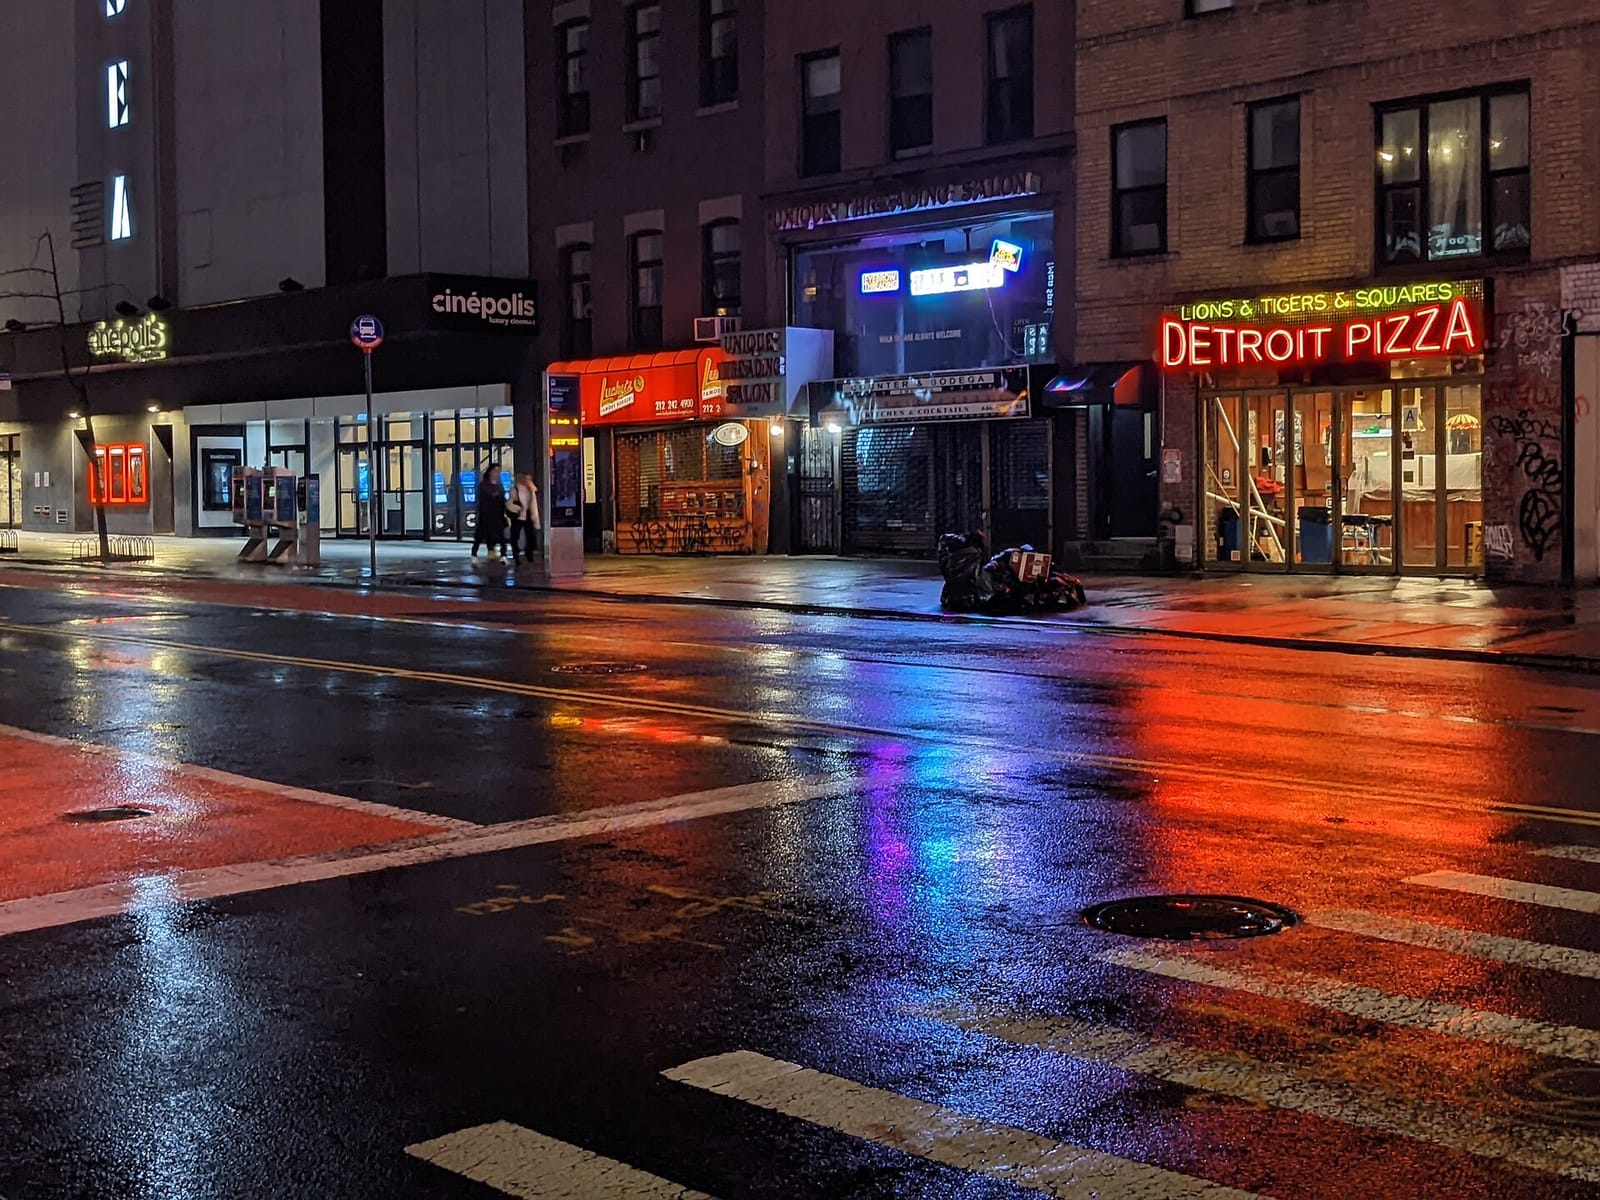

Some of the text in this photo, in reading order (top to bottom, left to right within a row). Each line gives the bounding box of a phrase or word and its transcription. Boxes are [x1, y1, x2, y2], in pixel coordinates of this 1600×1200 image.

[963, 173, 1034, 202] SALON
[432, 288, 536, 319] cinépolis
[1180, 283, 1453, 320] LIONS & TIGERS & SQUARES
[724, 332, 780, 357] UNIQUE
[1162, 319, 1332, 367] DETROIT
[1347, 299, 1476, 357] PIZZA
[931, 374, 985, 387] BODEGA
[655, 398, 694, 410] 212 242 4900
[726, 383, 780, 404] SALON
[917, 406, 969, 416] COCKTAILS
[1404, 409, 1415, 422] A
